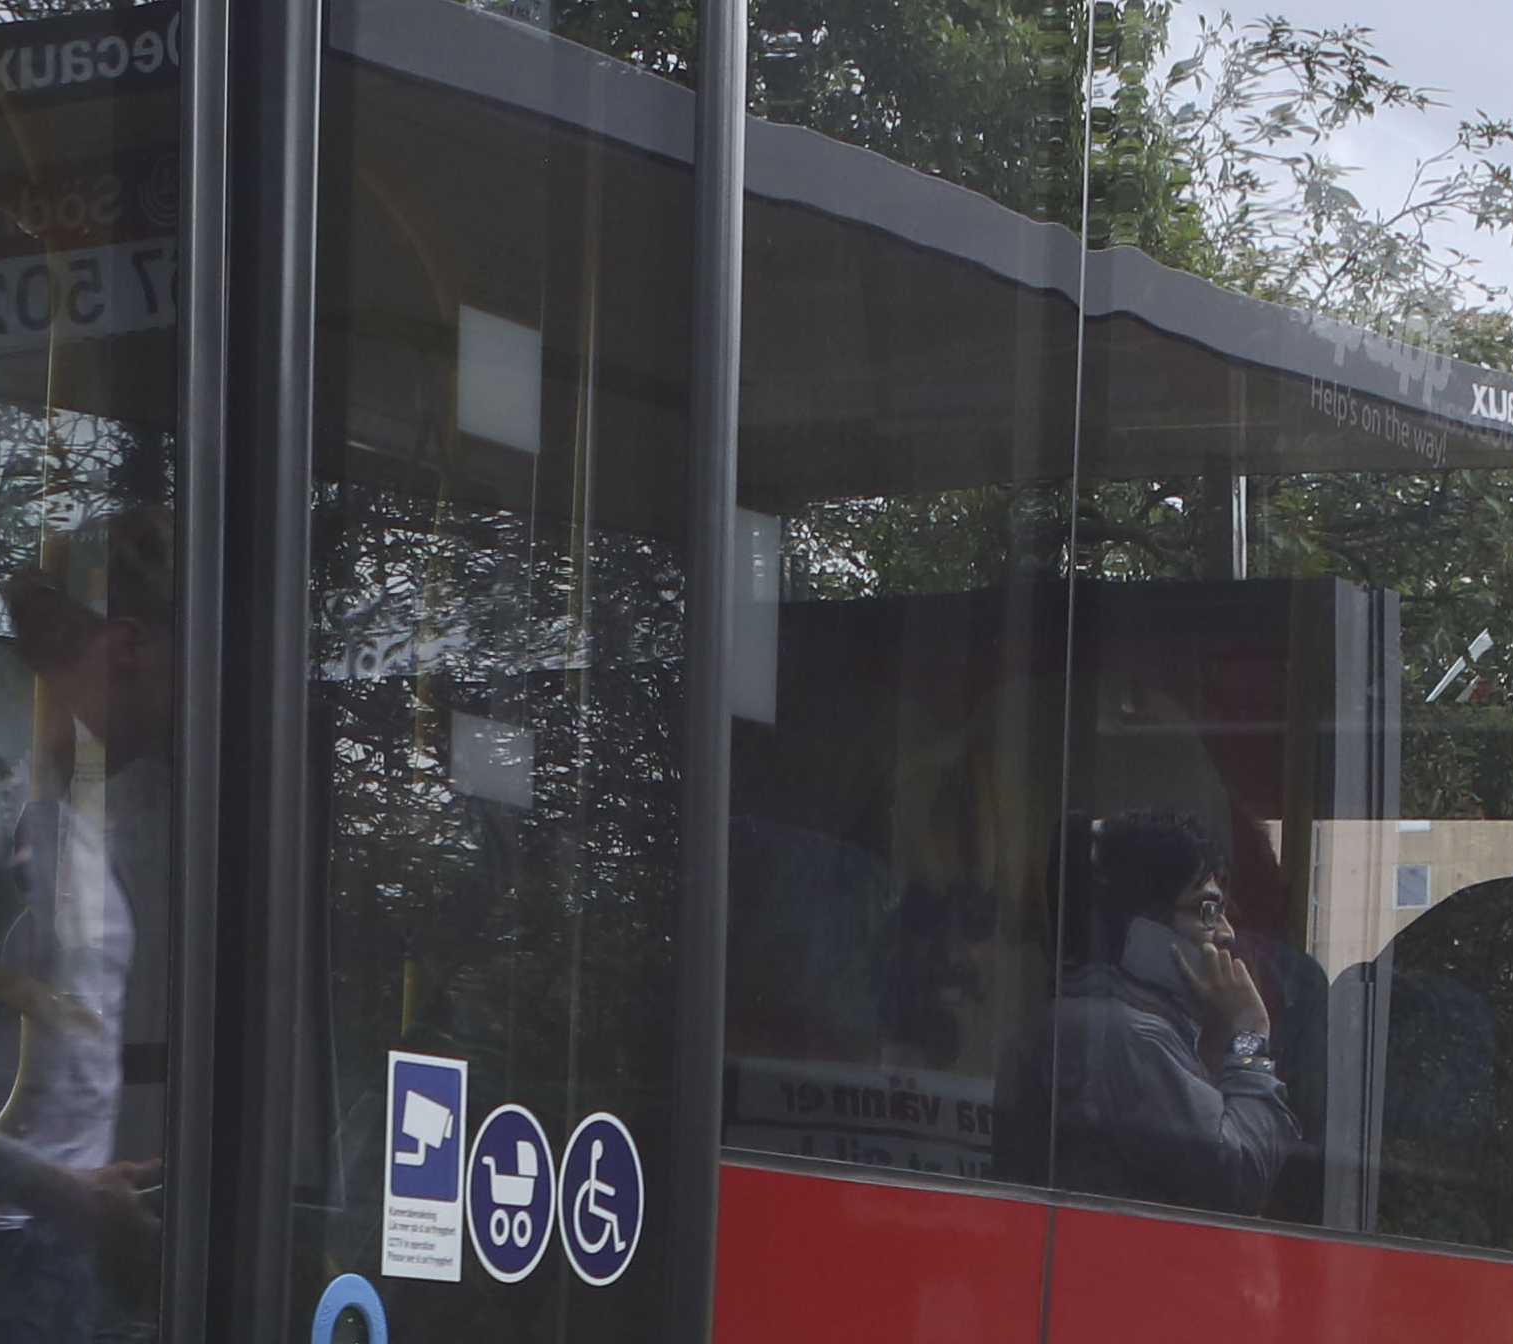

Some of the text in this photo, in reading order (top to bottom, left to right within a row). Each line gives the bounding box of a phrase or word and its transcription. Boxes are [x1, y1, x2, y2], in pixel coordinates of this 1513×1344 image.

[1310, 374, 1358, 428] Help's
[1361, 402, 1381, 436] on
[1384, 406, 1411, 448] the
[1413, 428, 1448, 470] way!
